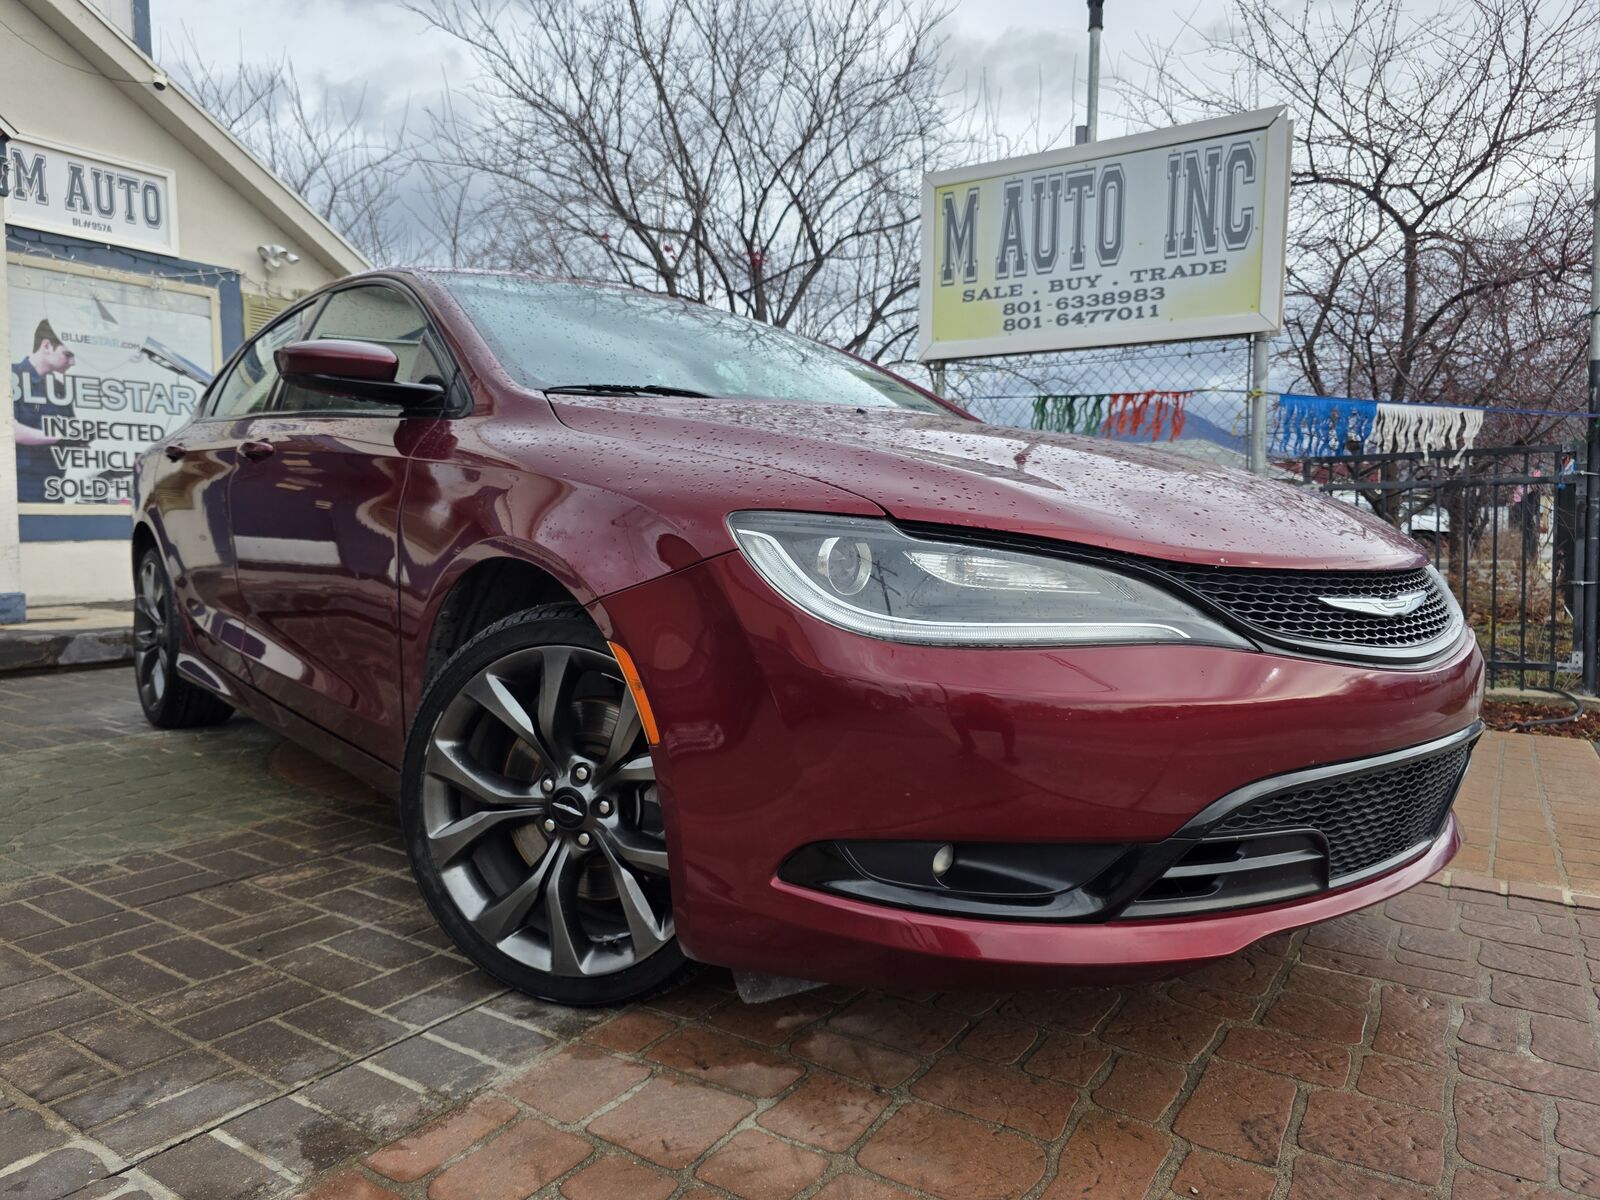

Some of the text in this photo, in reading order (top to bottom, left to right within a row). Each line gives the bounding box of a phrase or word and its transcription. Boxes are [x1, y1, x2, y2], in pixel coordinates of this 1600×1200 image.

[11, 148, 162, 229] M AUTO
[940, 141, 1257, 286] M AUTO INC
[961, 284, 1023, 303] SALE
[1048, 275, 1102, 293] BUY
[1130, 260, 1228, 283] TRADE
[1002, 286, 1166, 316] 801-6338983
[1002, 304, 1160, 332] 801-6477011
[44, 418, 165, 441] INSPECTED
[46, 478, 109, 499] SOLD
